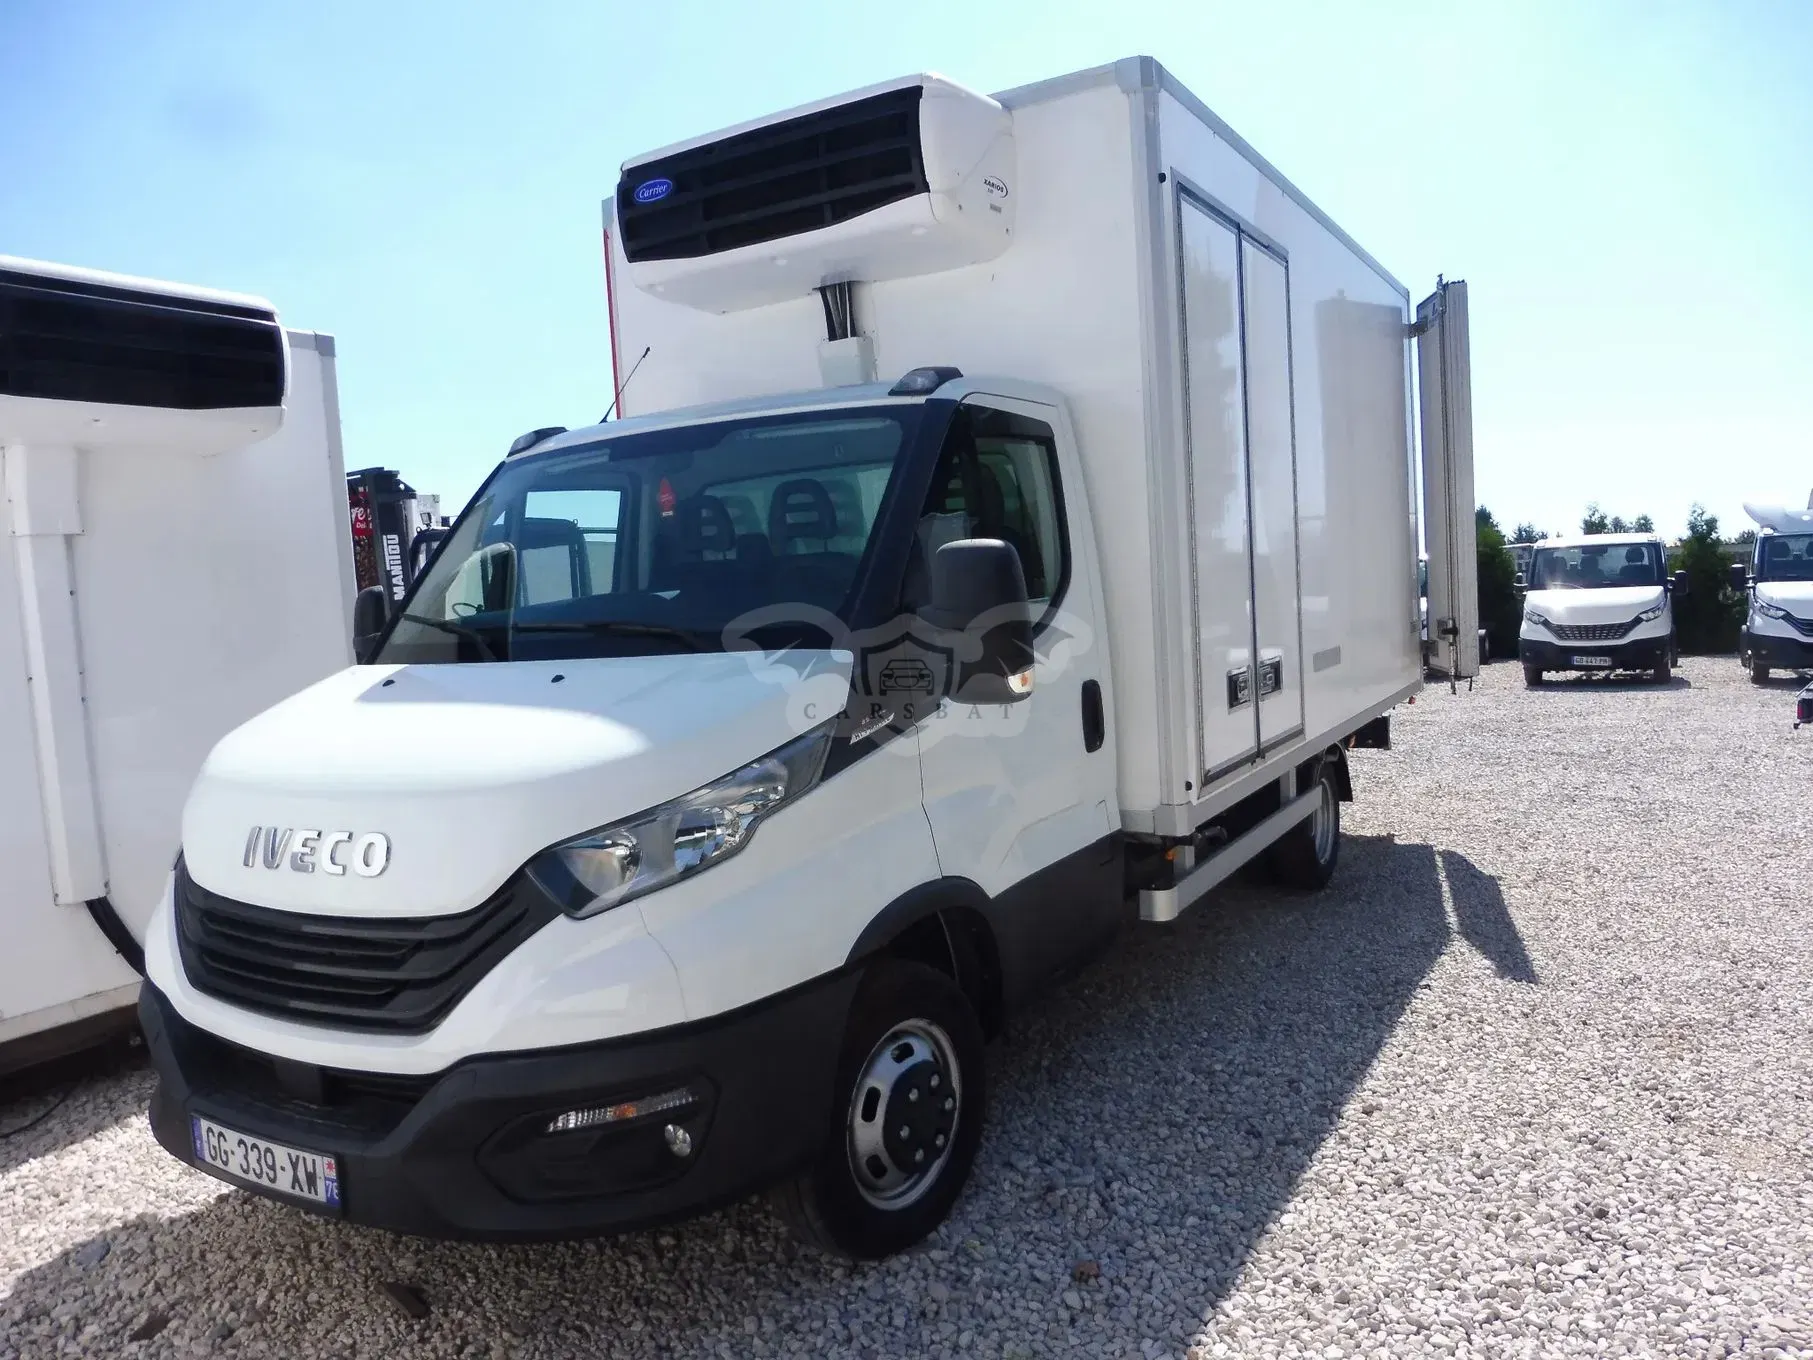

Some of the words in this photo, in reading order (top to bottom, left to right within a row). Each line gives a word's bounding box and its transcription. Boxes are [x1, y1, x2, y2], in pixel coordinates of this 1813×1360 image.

[639, 184, 668, 198] Carrier
[383, 534, 406, 601] MANITOU
[243, 826, 392, 878] IVECO
[206, 1126, 319, 1196] GG-339-XW
